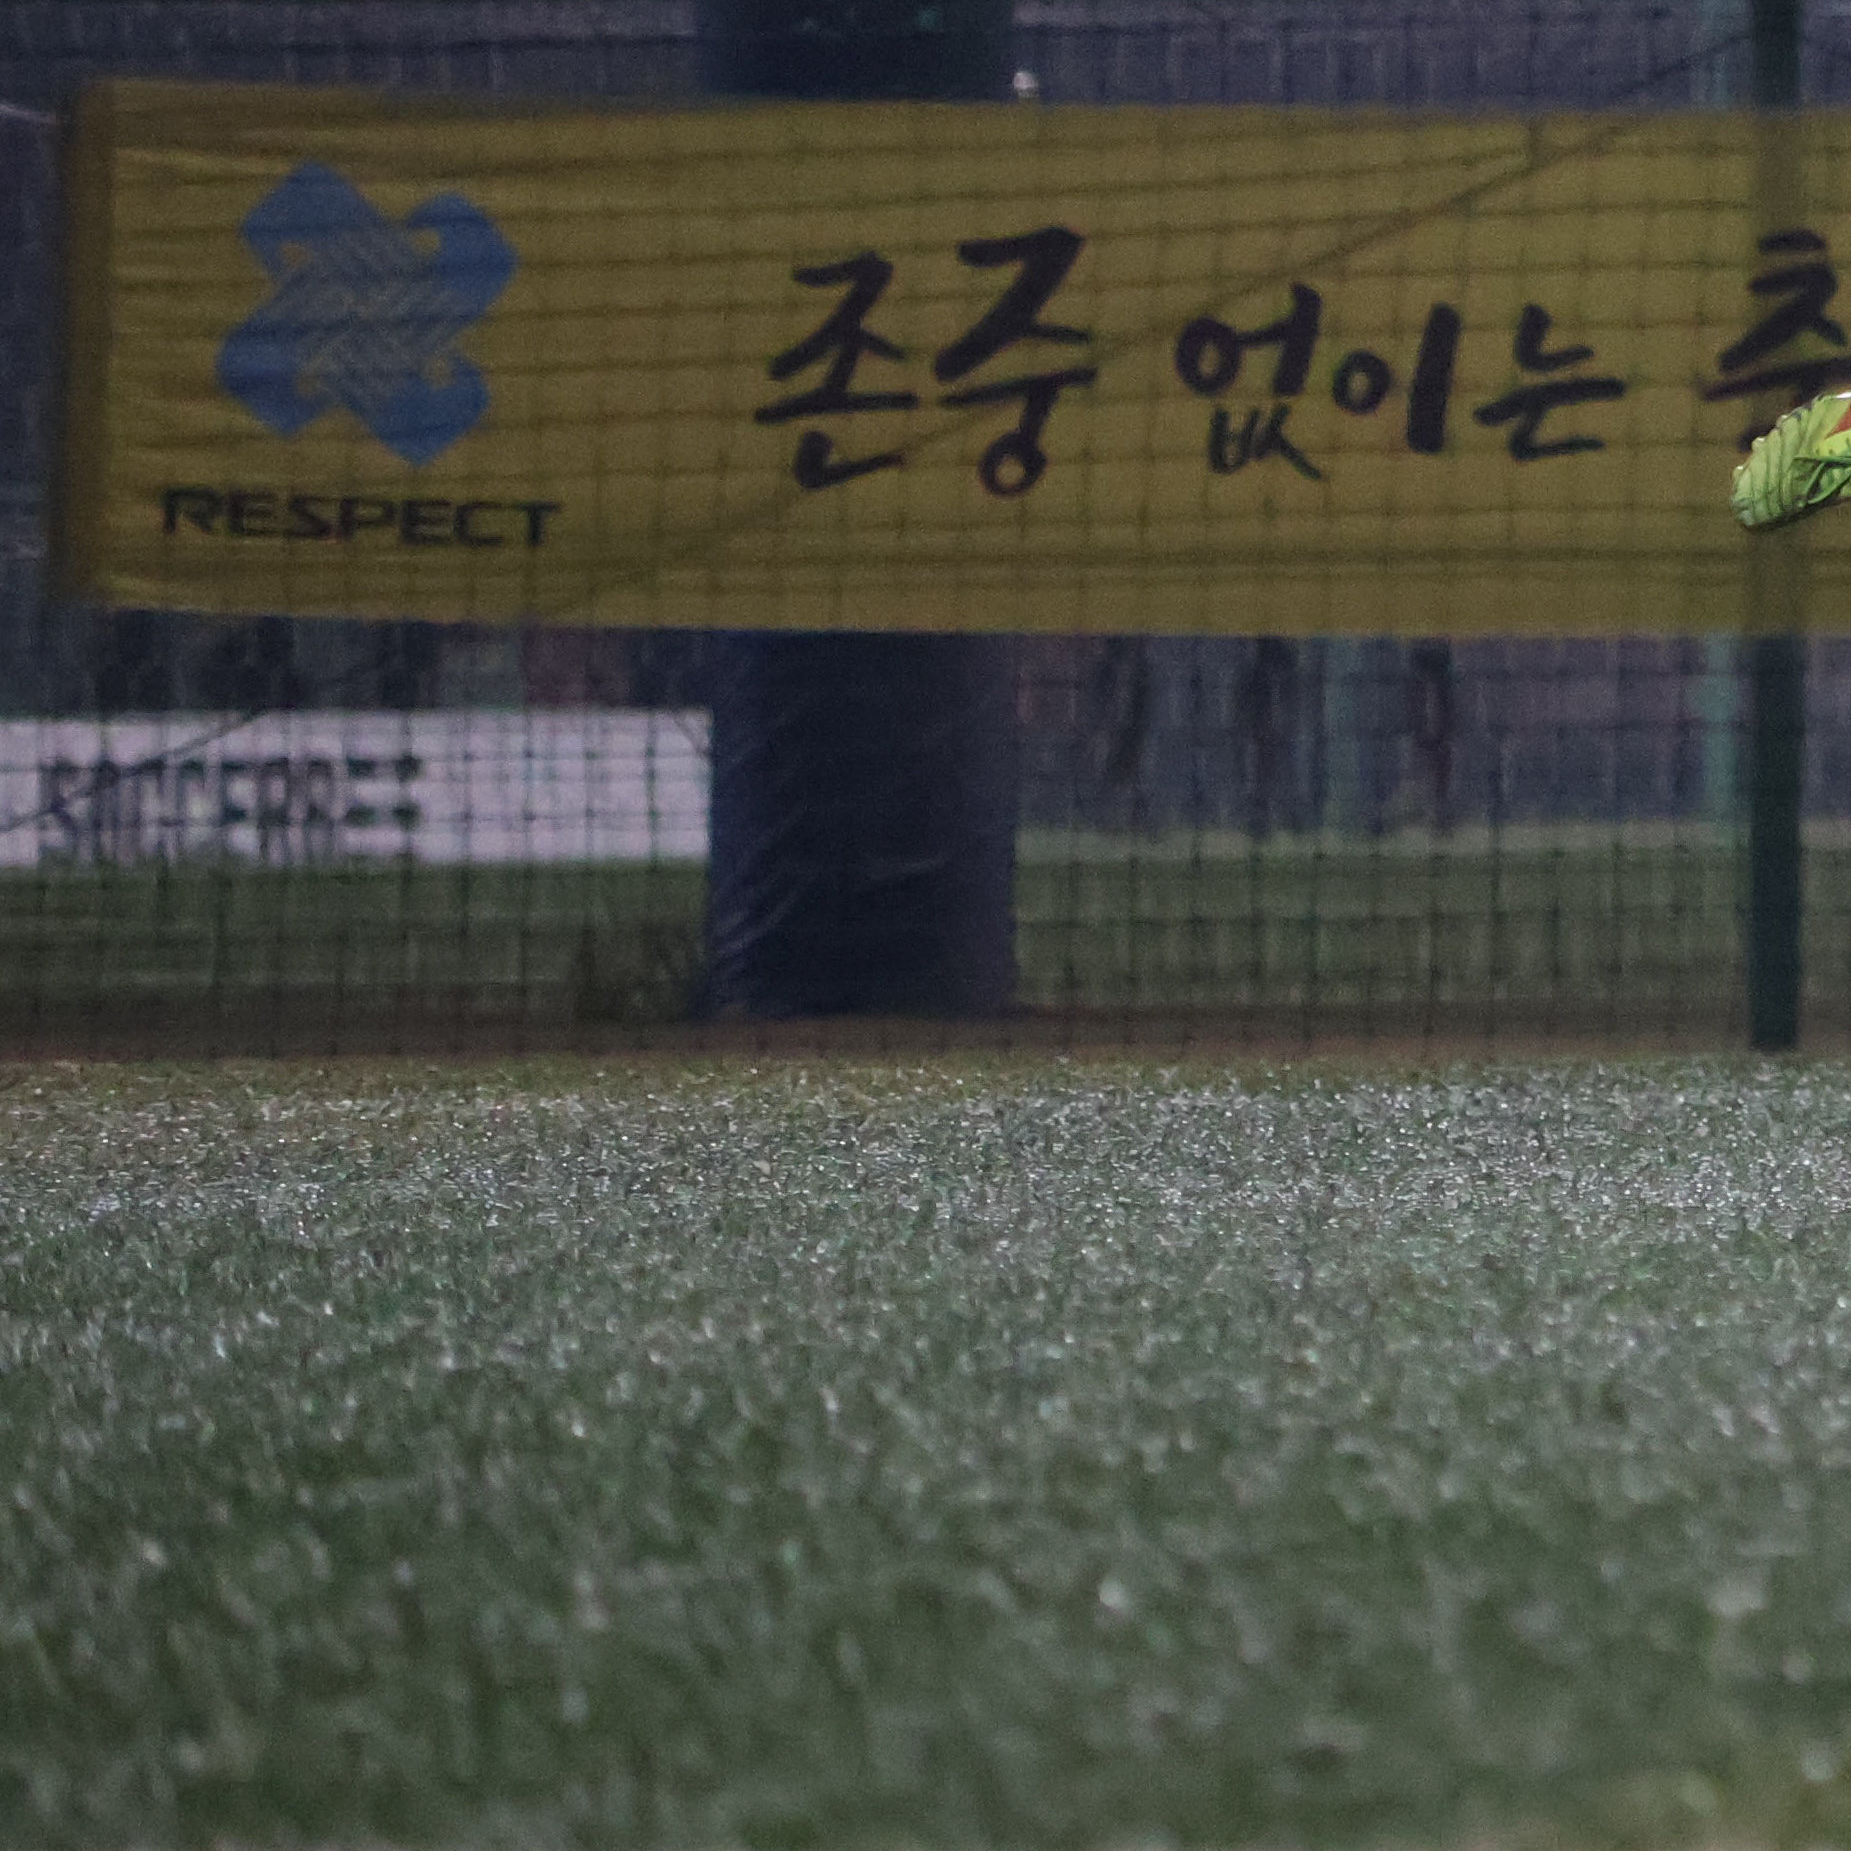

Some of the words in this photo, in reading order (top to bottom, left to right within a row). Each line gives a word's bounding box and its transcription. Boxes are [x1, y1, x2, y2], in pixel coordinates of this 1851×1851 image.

[752, 226, 1098, 497] 존중
[1173, 281, 1629, 482] 없이는
[159, 485, 562, 549] RESPECT
